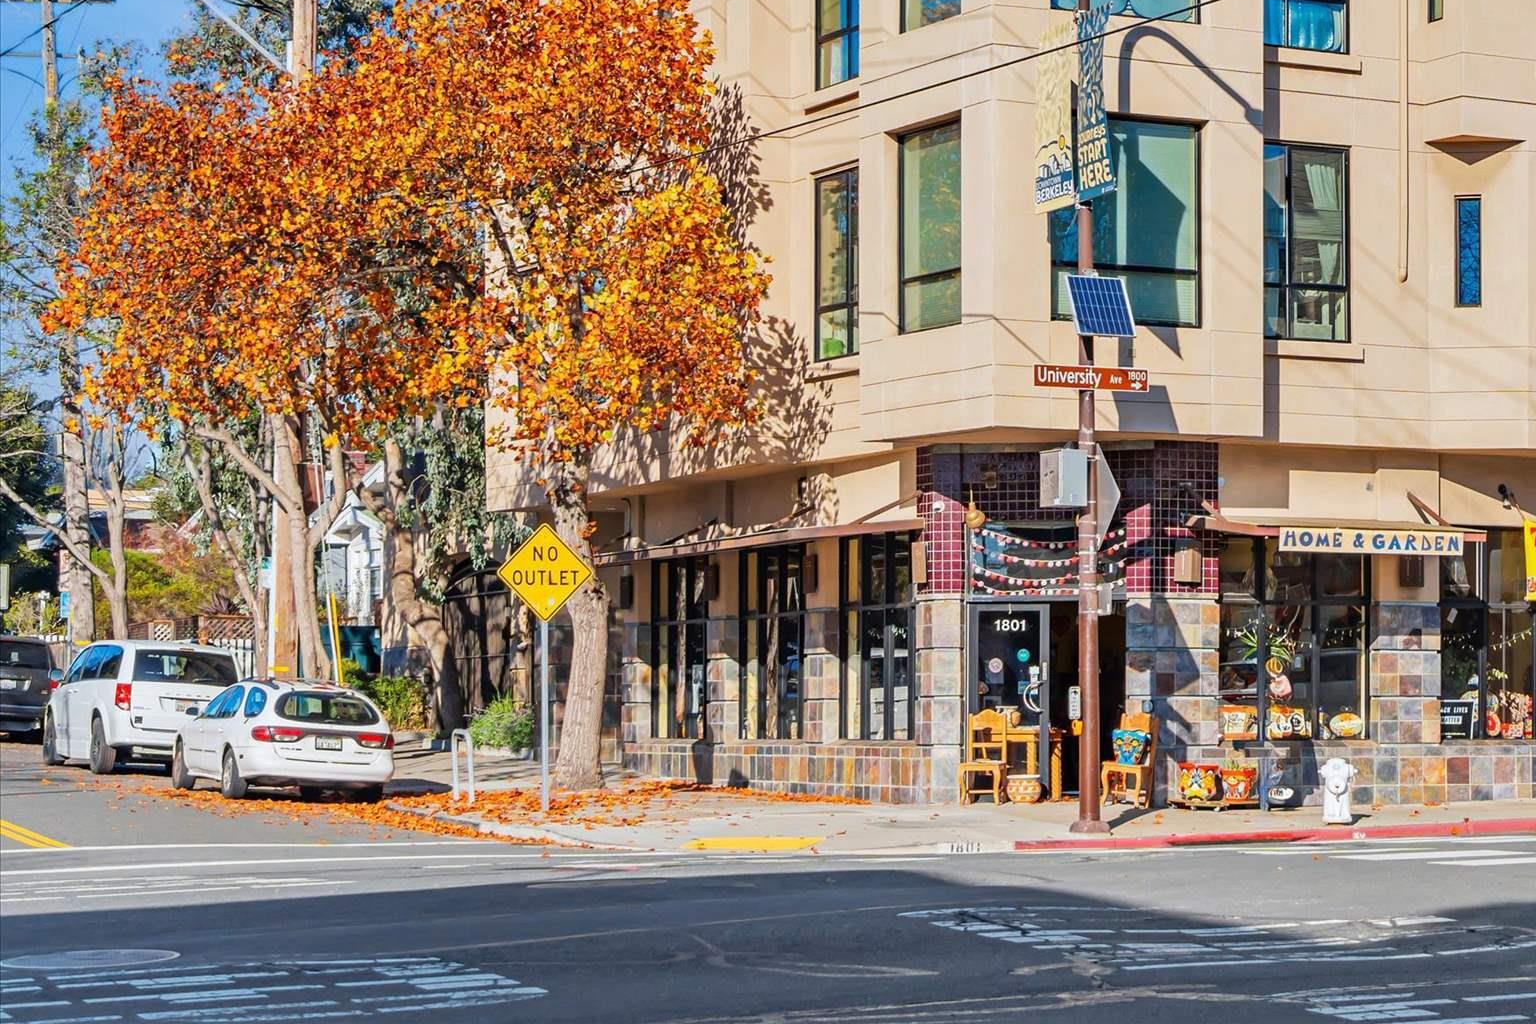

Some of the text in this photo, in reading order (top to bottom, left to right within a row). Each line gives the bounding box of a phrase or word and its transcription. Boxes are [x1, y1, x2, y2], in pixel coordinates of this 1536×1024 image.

[1078, 138, 1107, 166] START
[1079, 159, 1112, 191] HERE
[1035, 180, 1073, 203] BERKELEY
[1037, 366, 1147, 388] University Ave 1800
[1283, 530, 1460, 552] HOME & GARDEN
[533, 546, 558, 562] NO
[512, 570, 579, 586] OUTLET
[994, 619, 1026, 631] 1801
[1453, 706, 1469, 714] LIVES
